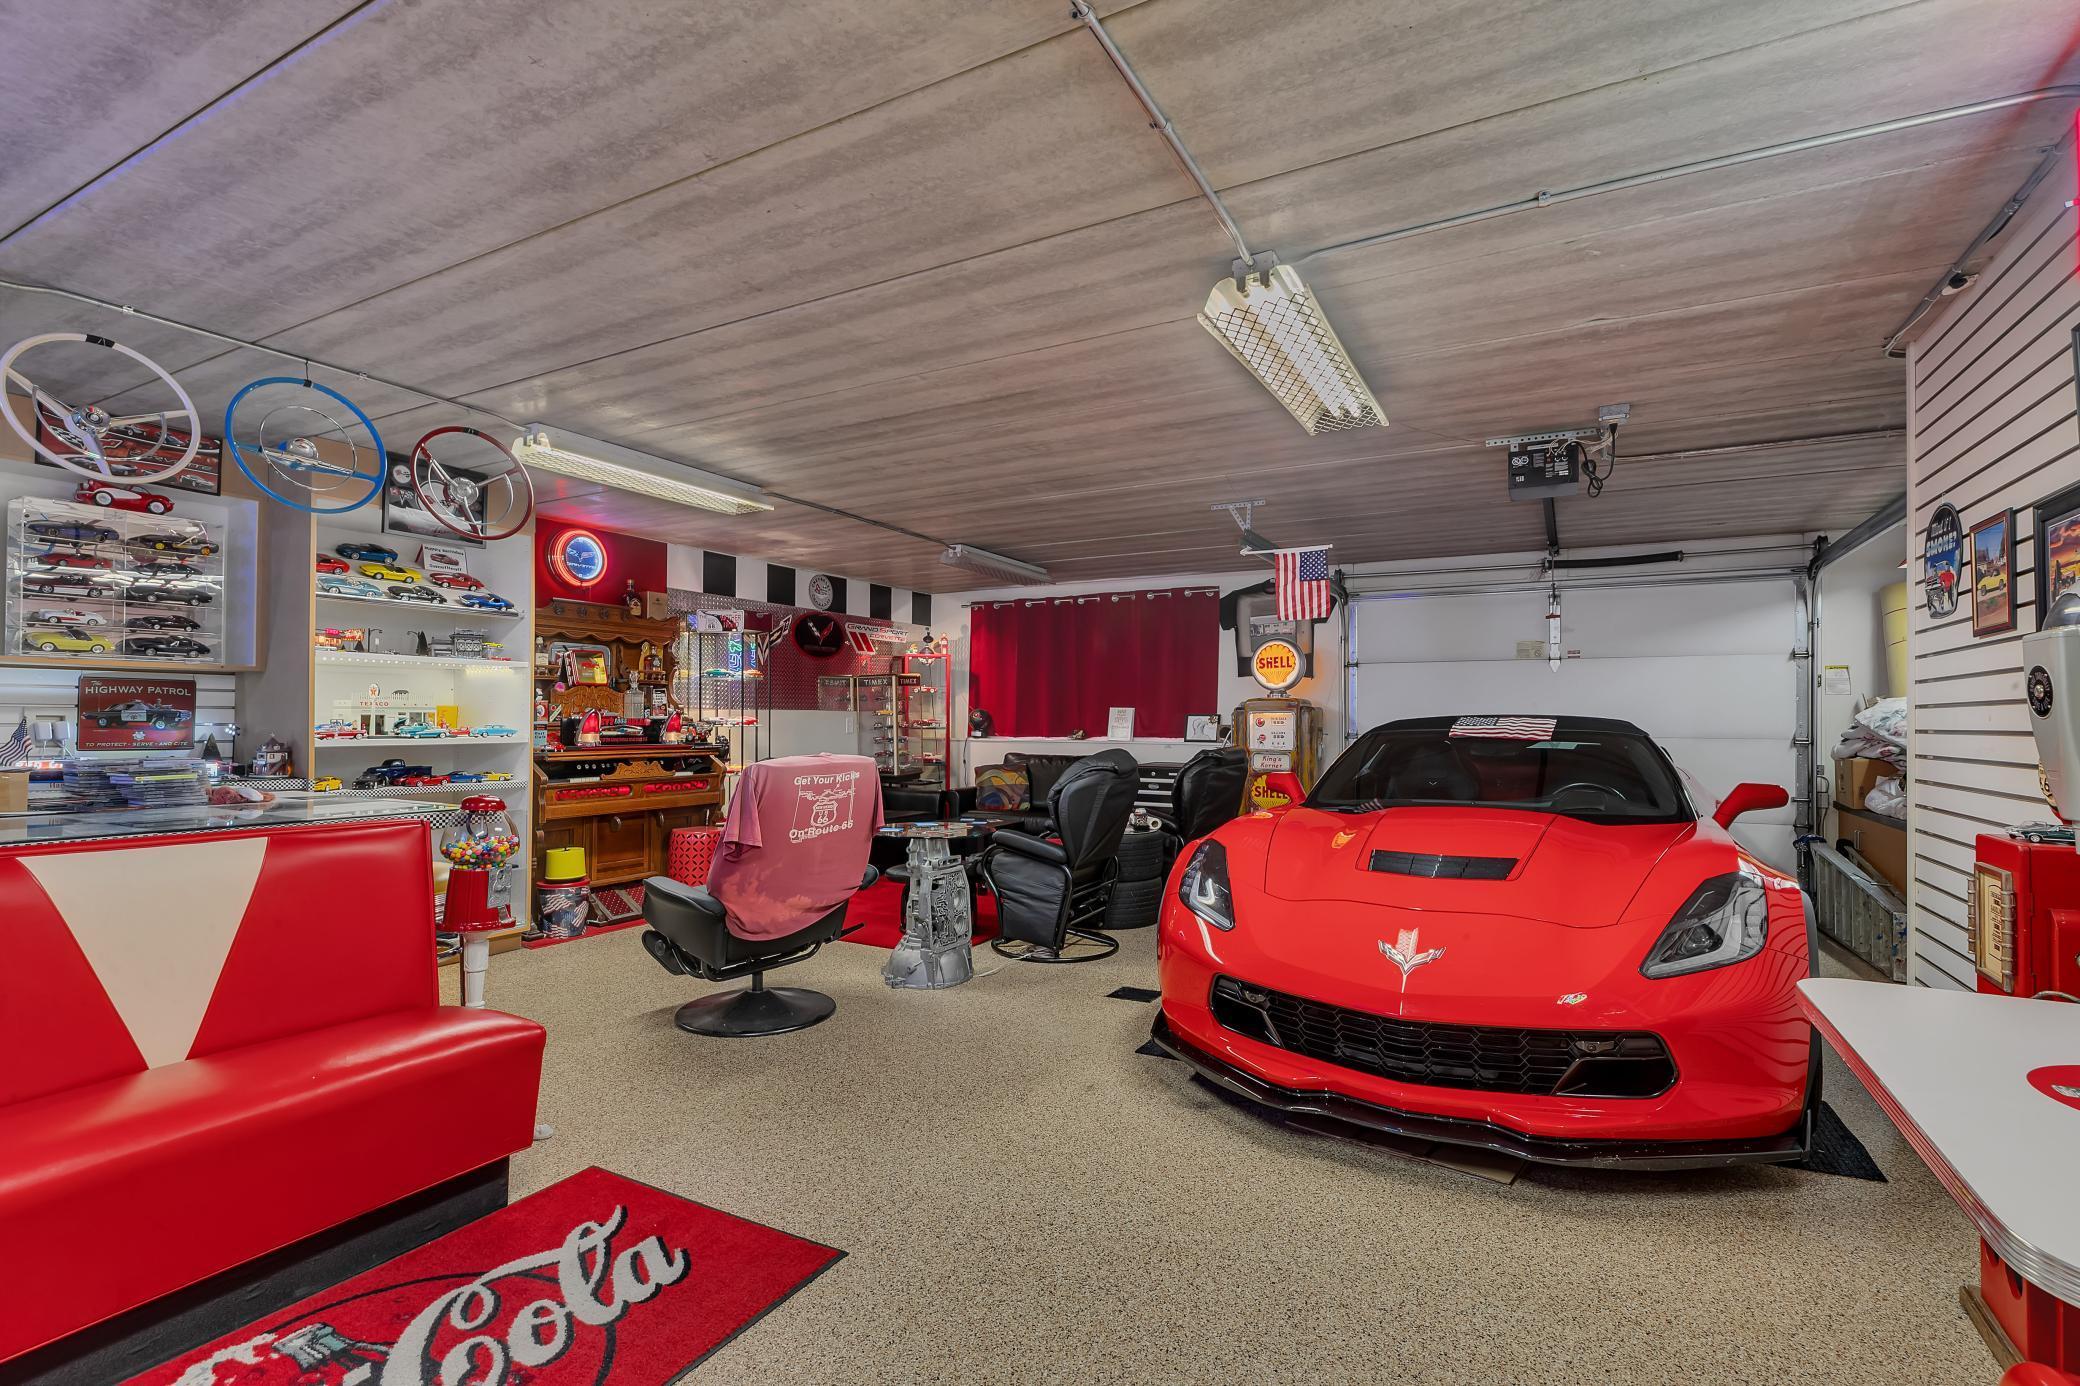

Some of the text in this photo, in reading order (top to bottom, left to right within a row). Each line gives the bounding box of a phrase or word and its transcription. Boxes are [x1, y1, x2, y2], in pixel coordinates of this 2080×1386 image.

[847, 624, 909, 636] GRAND SPORT
[1258, 656, 1292, 669] SHELL
[85, 686, 191, 696] HIGHWAY PATROL
[794, 777, 810, 785] Get
[813, 776, 834, 784] Your
[789, 820, 854, 838] On Route 66
